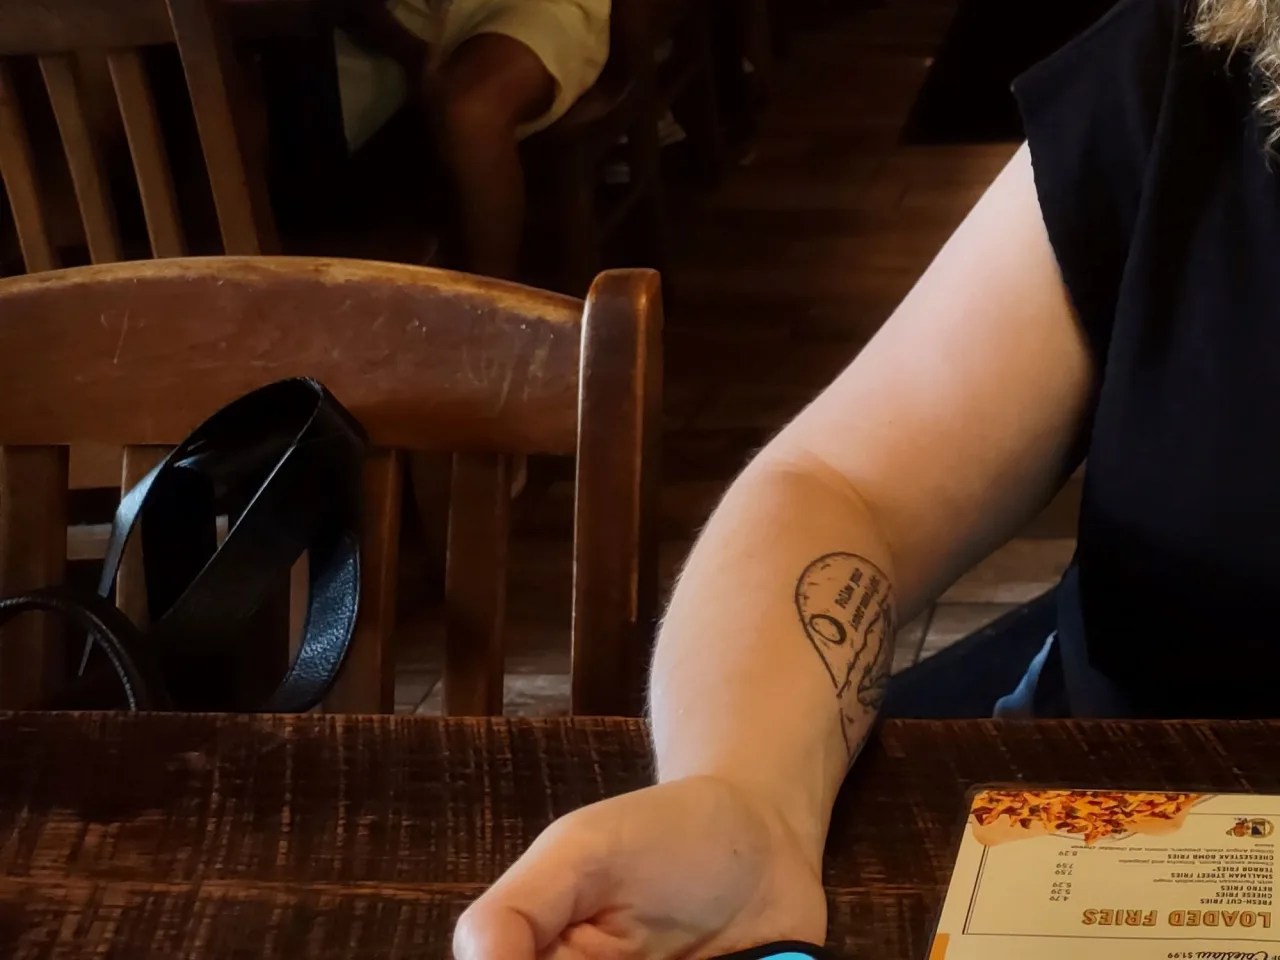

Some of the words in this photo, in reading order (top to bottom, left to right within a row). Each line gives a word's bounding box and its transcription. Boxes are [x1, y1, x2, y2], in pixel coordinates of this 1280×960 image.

[1226, 898, 1272, 906] FRESH-CUT
[1081, 908, 1158, 927] FRIES
[1168, 909, 1271, 928] LOADED
[1195, 951, 1268, 960] Coleslaw
